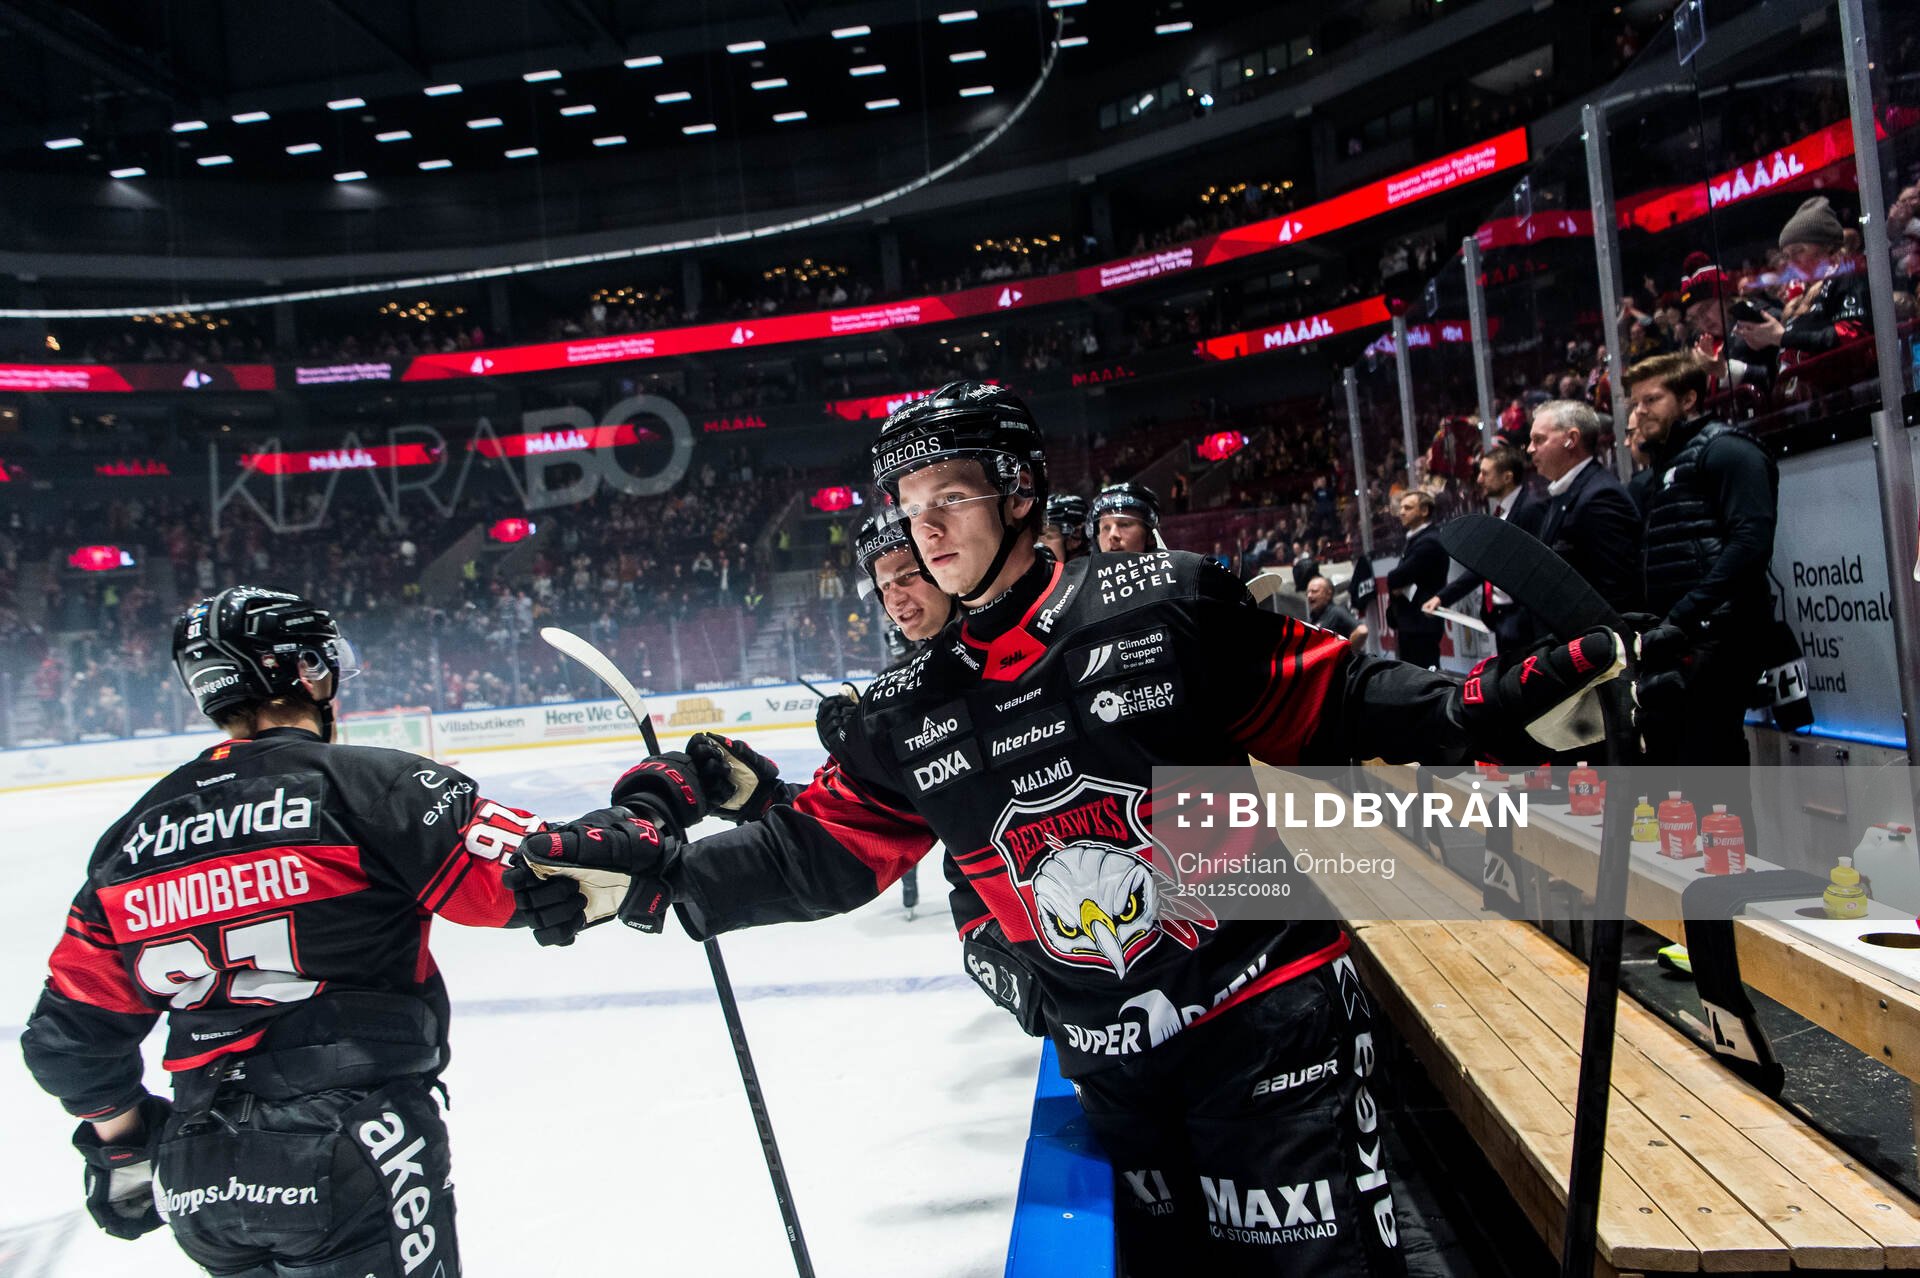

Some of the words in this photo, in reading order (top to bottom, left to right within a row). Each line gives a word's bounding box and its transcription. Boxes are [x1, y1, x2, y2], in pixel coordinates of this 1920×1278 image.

[1709, 151, 1804, 208] MÅÅÅL
[1263, 315, 1334, 349] MÅÅÅL
[1100, 560, 1173, 590] ARENA
[1793, 555, 1864, 588] Ronald
[1103, 573, 1176, 604] HOTEL
[1117, 632, 1163, 650] Climat80
[1120, 645, 1163, 661] Gruppen
[1801, 632, 1840, 658] Hus
[1000, 649, 1026, 669] SHL
[872, 676, 922, 702] HOTEL
[1003, 687, 1042, 709] BAUER
[1119, 694, 1175, 717] ENERGY
[1123, 682, 1173, 704] CHEAP
[439, 715, 526, 735] Villabutiken
[544, 708, 587, 725] Here
[586, 706, 613, 722] We
[905, 718, 958, 751] TREANO
[991, 720, 1066, 757] Interbus
[913, 750, 972, 792] DOXA
[1011, 757, 1073, 795] MALMÖ
[153, 788, 312, 857] bravida
[1005, 796, 1129, 876] REDHAWKS
[123, 855, 310, 933] SUNDBERG
[1063, 1021, 1143, 1056] SUPER
[1252, 1059, 1339, 1097] BAUER
[1354, 1031, 1399, 1249] akea
[359, 1112, 436, 1276] akea
[1200, 1175, 1336, 1228] MAXI
[1226, 1222, 1339, 1246] STORMARKNAD
